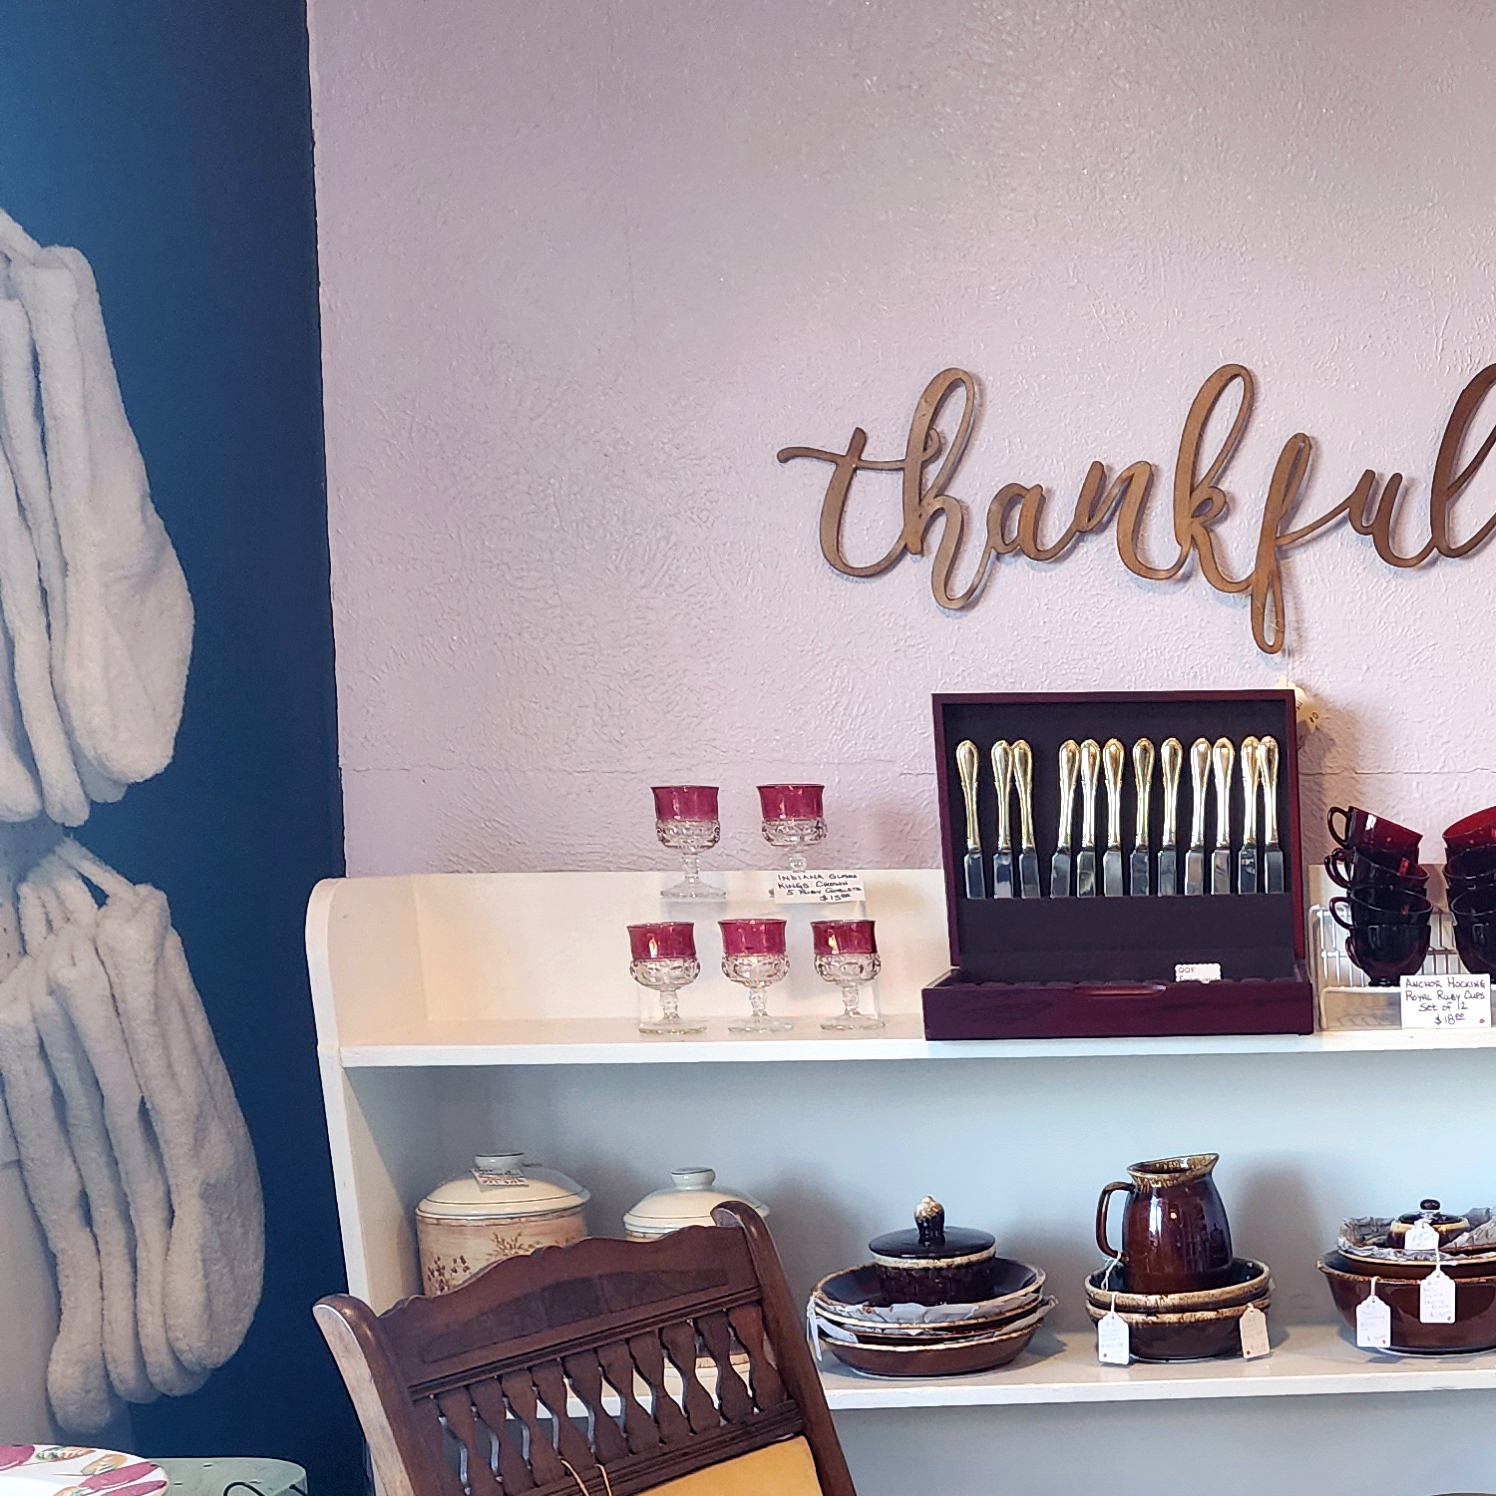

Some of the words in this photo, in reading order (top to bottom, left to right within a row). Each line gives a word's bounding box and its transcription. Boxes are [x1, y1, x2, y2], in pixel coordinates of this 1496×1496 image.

[777, 873, 825, 881] INDIANA
[1405, 978, 1443, 989] ANCHOR
[1447, 976, 1486, 989] HOCKING
[1405, 990, 1432, 1002] ROYAL
[1436, 990, 1461, 1002] RUBY
[1457, 1001, 1469, 1010] 12
